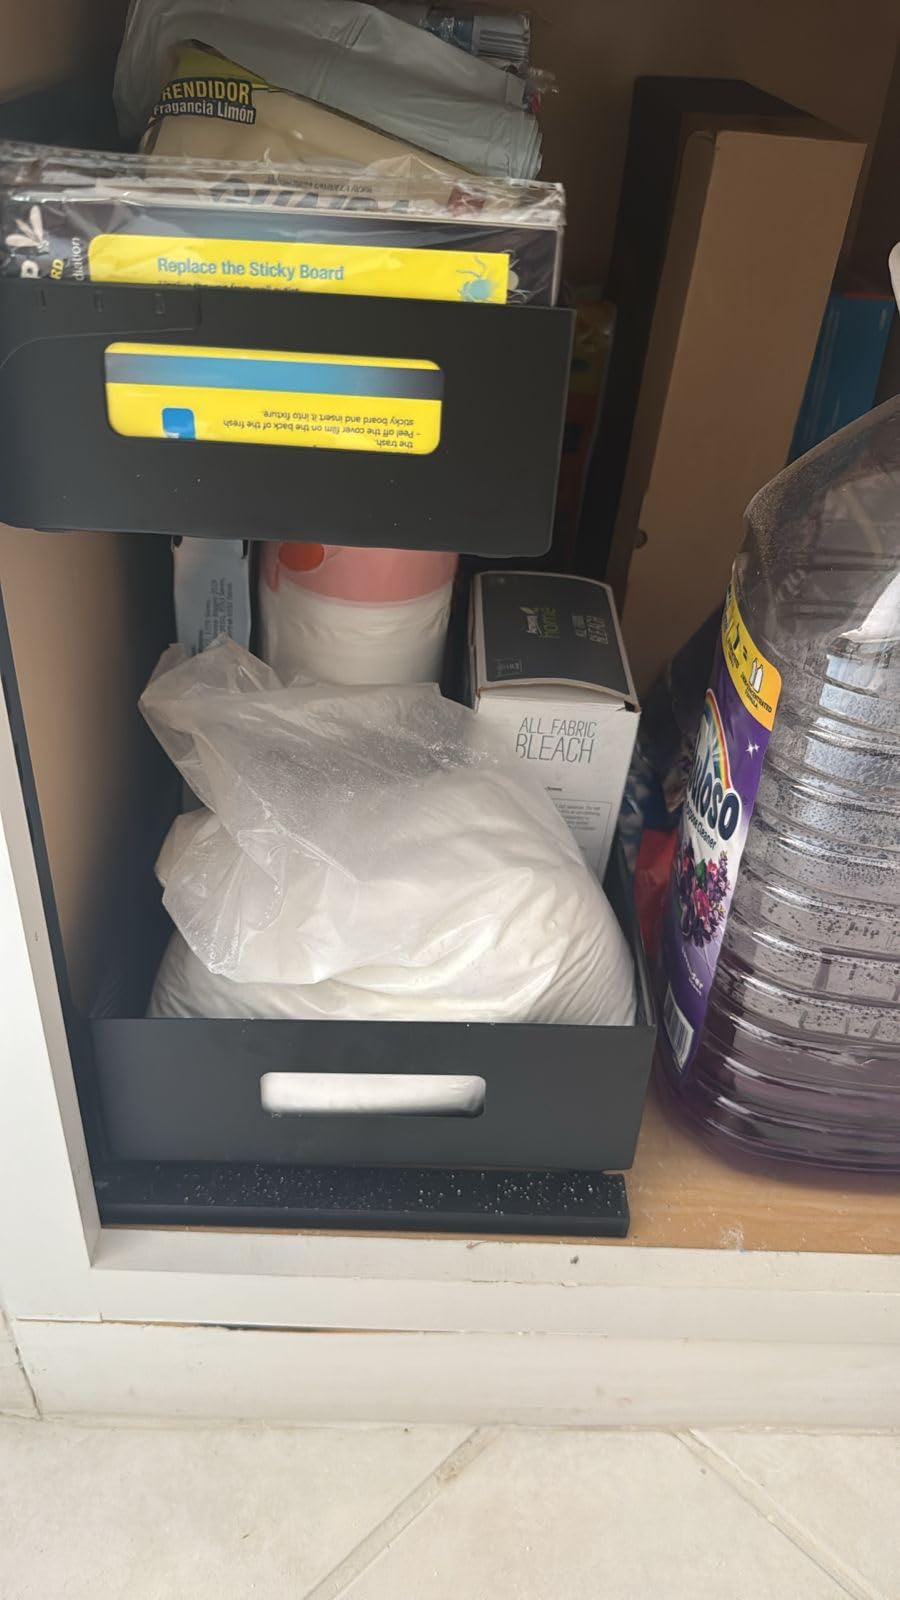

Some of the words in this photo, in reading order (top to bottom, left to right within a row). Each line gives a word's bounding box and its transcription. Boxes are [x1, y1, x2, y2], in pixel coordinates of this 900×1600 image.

[162, 81, 250, 105] RENDIDOR
[153, 100, 213, 116] Fragancia
[217, 101, 255, 123] Limón
[157, 257, 218, 276] Replace
[222, 260, 246, 276] the
[250, 262, 295, 281] Sticky
[300, 264, 345, 281] Board
[292, 411, 309, 420] into
[311, 413, 318, 421] it
[319, 414, 343, 424] insert
[345, 415, 361, 424] and
[223, 419, 245, 429] fresh
[247, 420, 261, 430] the
[263, 421, 272, 430] of
[363, 416, 388, 426] board
[390, 416, 414, 427] sticky
[273, 422, 294, 432] back
[295, 423, 309, 432] the
[324, 426, 340, 434] film
[367, 428, 381, 437] the
[382, 429, 395, 438] off
[396, 429, 414, 438] Peel
[399, 440, 414, 449] the
[518, 717, 545, 734] ALL
[551, 718, 598, 738] FABRIC
[515, 733, 595, 764] BLEACH
[686, 744, 741, 841] uloso
